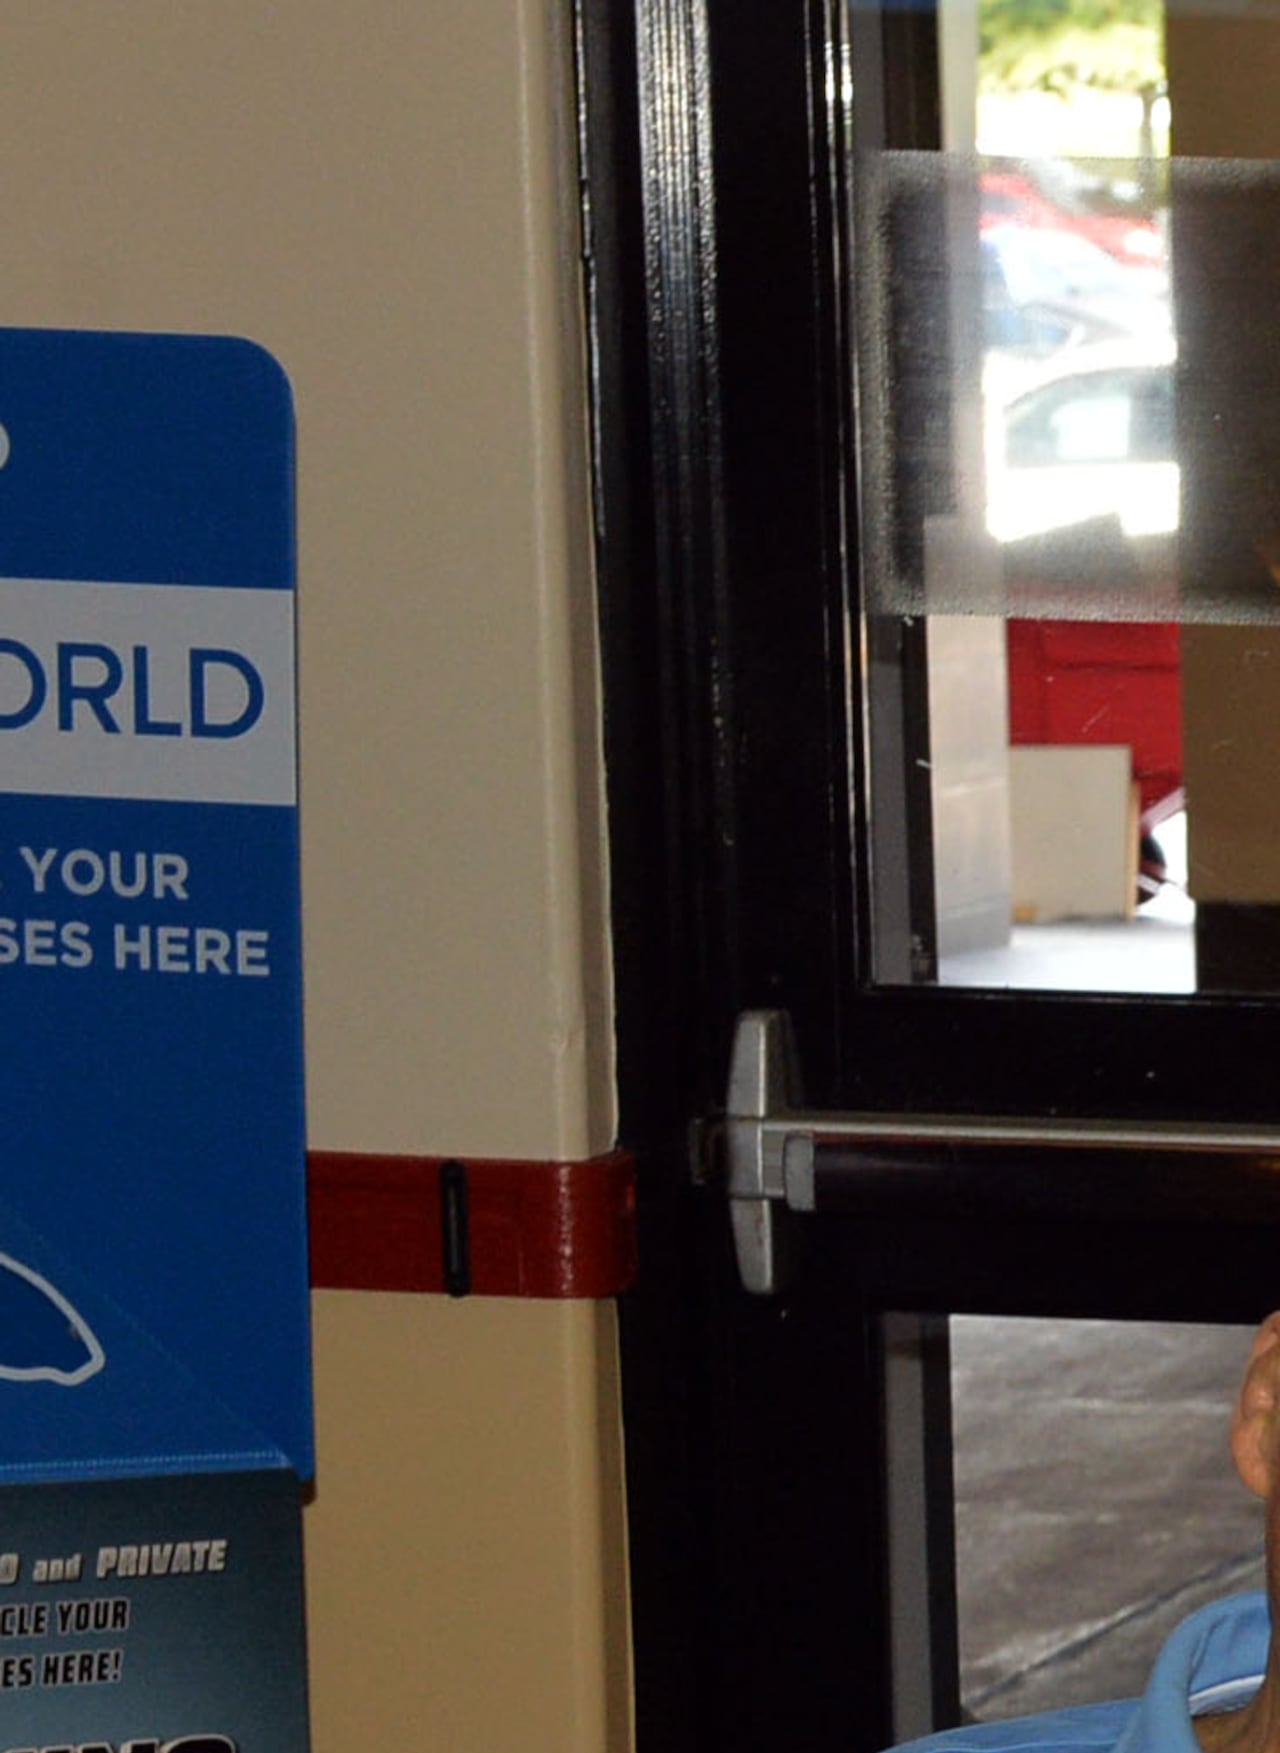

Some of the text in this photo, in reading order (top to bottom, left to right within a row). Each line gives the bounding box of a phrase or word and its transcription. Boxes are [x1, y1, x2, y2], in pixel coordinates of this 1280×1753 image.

[19, 846, 190, 899] YOUR
[114, 923, 270, 976] HERE
[32, 1553, 83, 1583] and
[96, 1539, 228, 1579] PRIVATE
[57, 1598, 130, 1634] YOUR
[42, 1650, 123, 1686] HERE!
